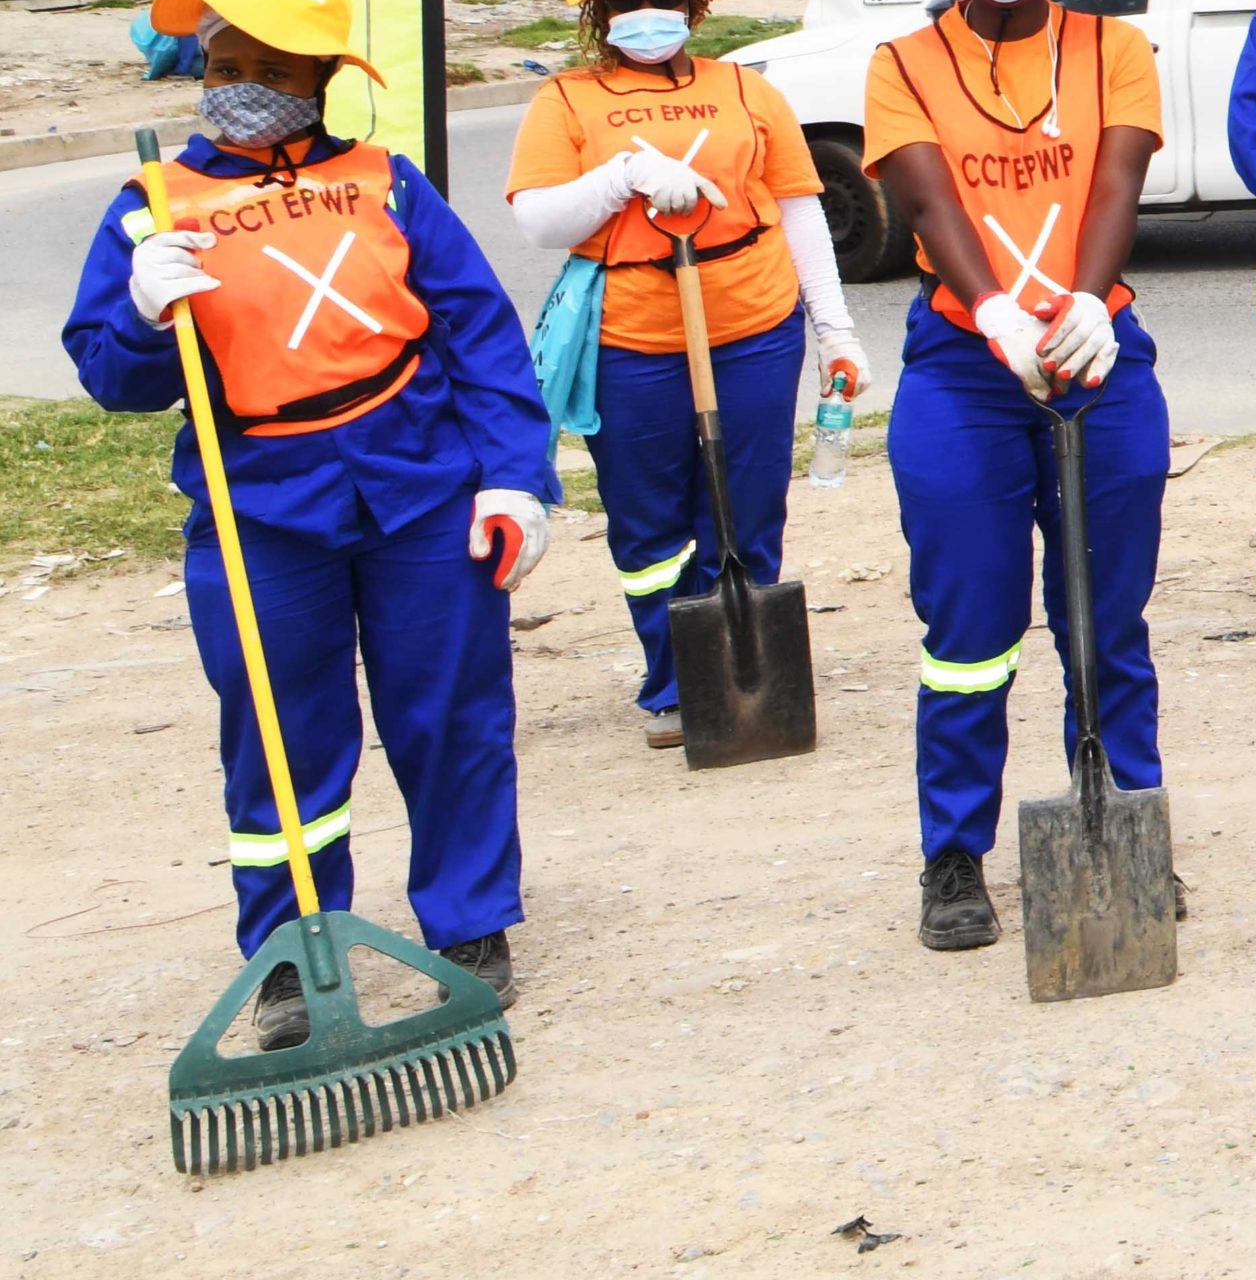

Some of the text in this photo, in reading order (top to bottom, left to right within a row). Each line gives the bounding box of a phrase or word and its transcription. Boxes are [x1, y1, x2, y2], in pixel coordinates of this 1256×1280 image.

[607, 104, 719, 128] CCT EPWP
[961, 143, 1074, 190] CCT EPWP
[209, 182, 361, 236] CCT EPWP
